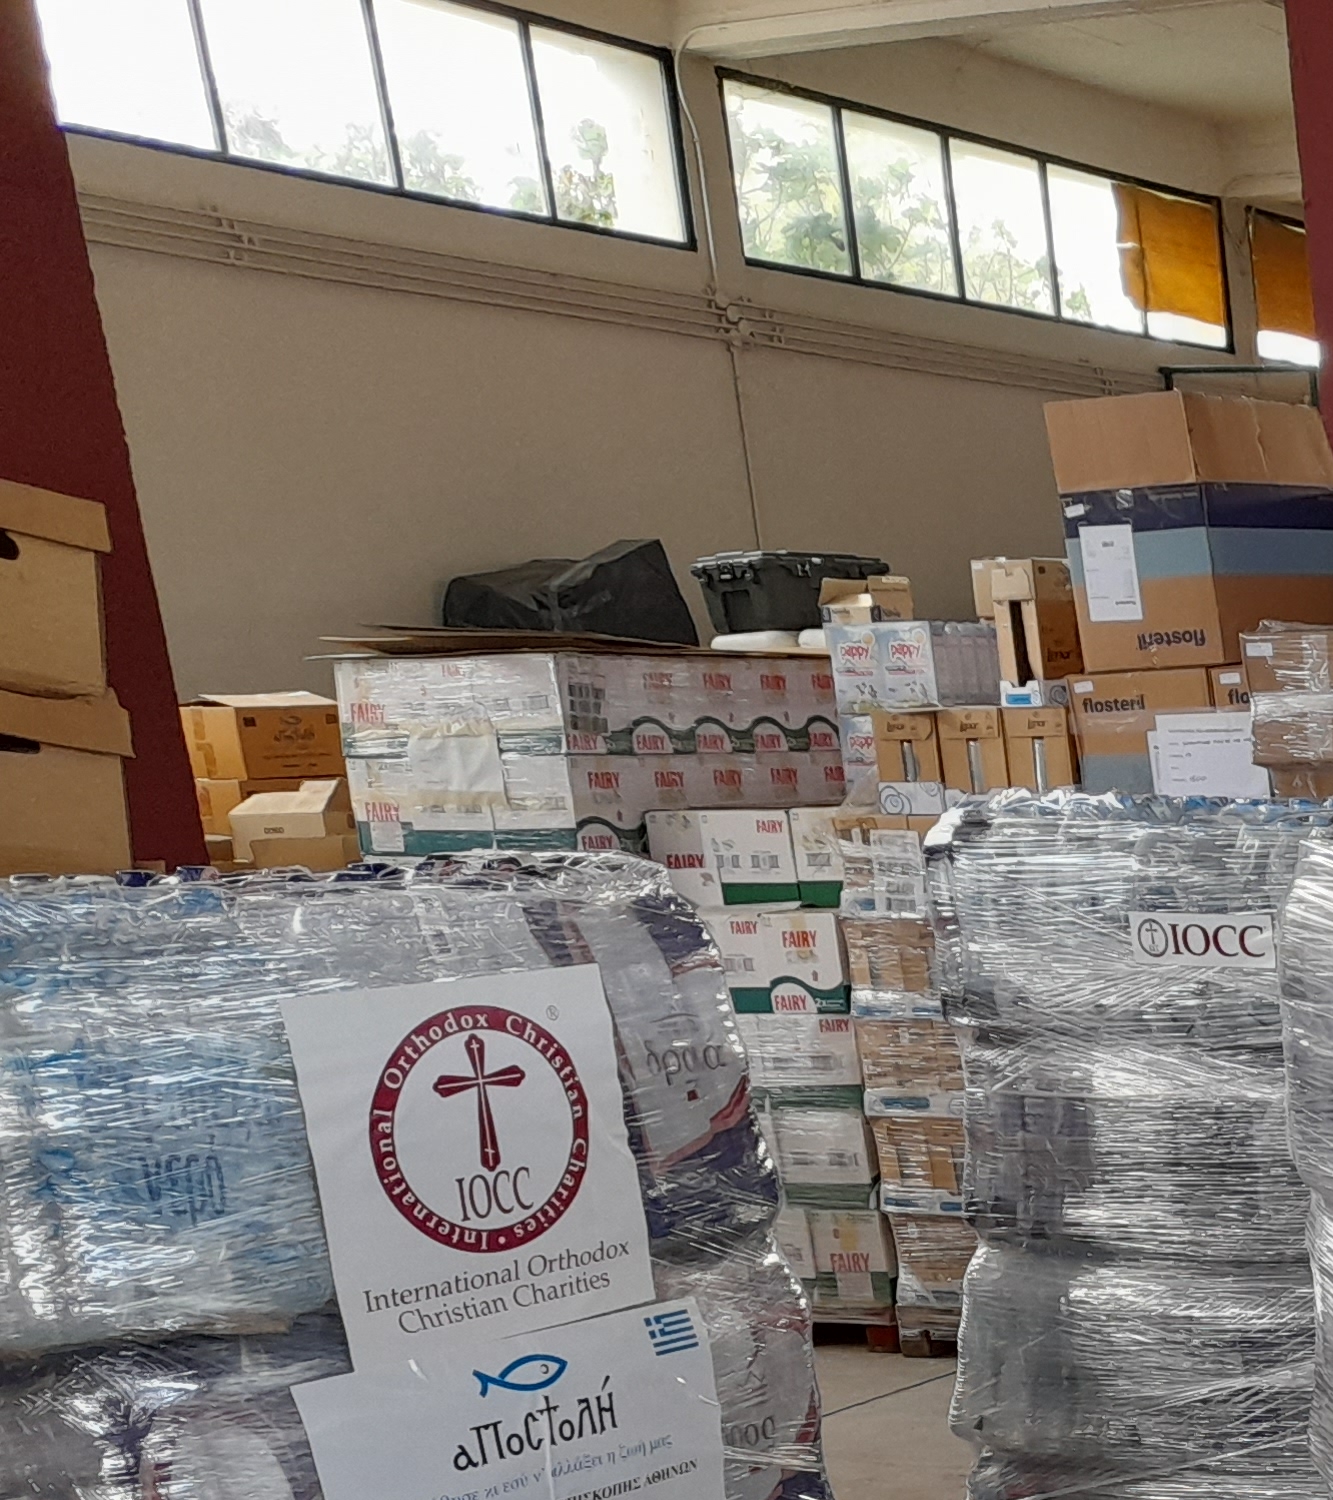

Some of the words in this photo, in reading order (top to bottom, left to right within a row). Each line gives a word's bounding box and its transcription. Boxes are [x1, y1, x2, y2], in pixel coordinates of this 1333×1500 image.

[1138, 629, 1206, 650] flosteril
[1083, 694, 1146, 714] flosteril
[636, 734, 666, 750] FAIRY
[696, 734, 725, 749] FAIRY
[587, 772, 620, 789] FAIRY
[756, 819, 783, 833] FAIRY
[582, 835, 613, 850] FAIRY
[667, 853, 705, 869] FAIRY
[730, 921, 757, 935] FAIRY
[782, 930, 817, 948] FAIRY
[1171, 922, 1266, 958] IOCC
[774, 995, 807, 1011] FAIRY
[819, 1018, 849, 1033] FAIRY
[384, 1011, 489, 1090] Orthodox
[505, 1015, 583, 1120] Christian
[373, 1108, 489, 1251] International
[513, 1138, 587, 1239] Charities
[455, 1166, 534, 1222] IOCC
[830, 1252, 870, 1274] FAIRY
[362, 1259, 521, 1314] International
[527, 1239, 631, 1277] Orthodox
[398, 1297, 509, 1334] Christian
[512, 1269, 611, 1309] Charities
[502, 1472, 529, 1494] εσύ
[605, 1449, 616, 1466] η
